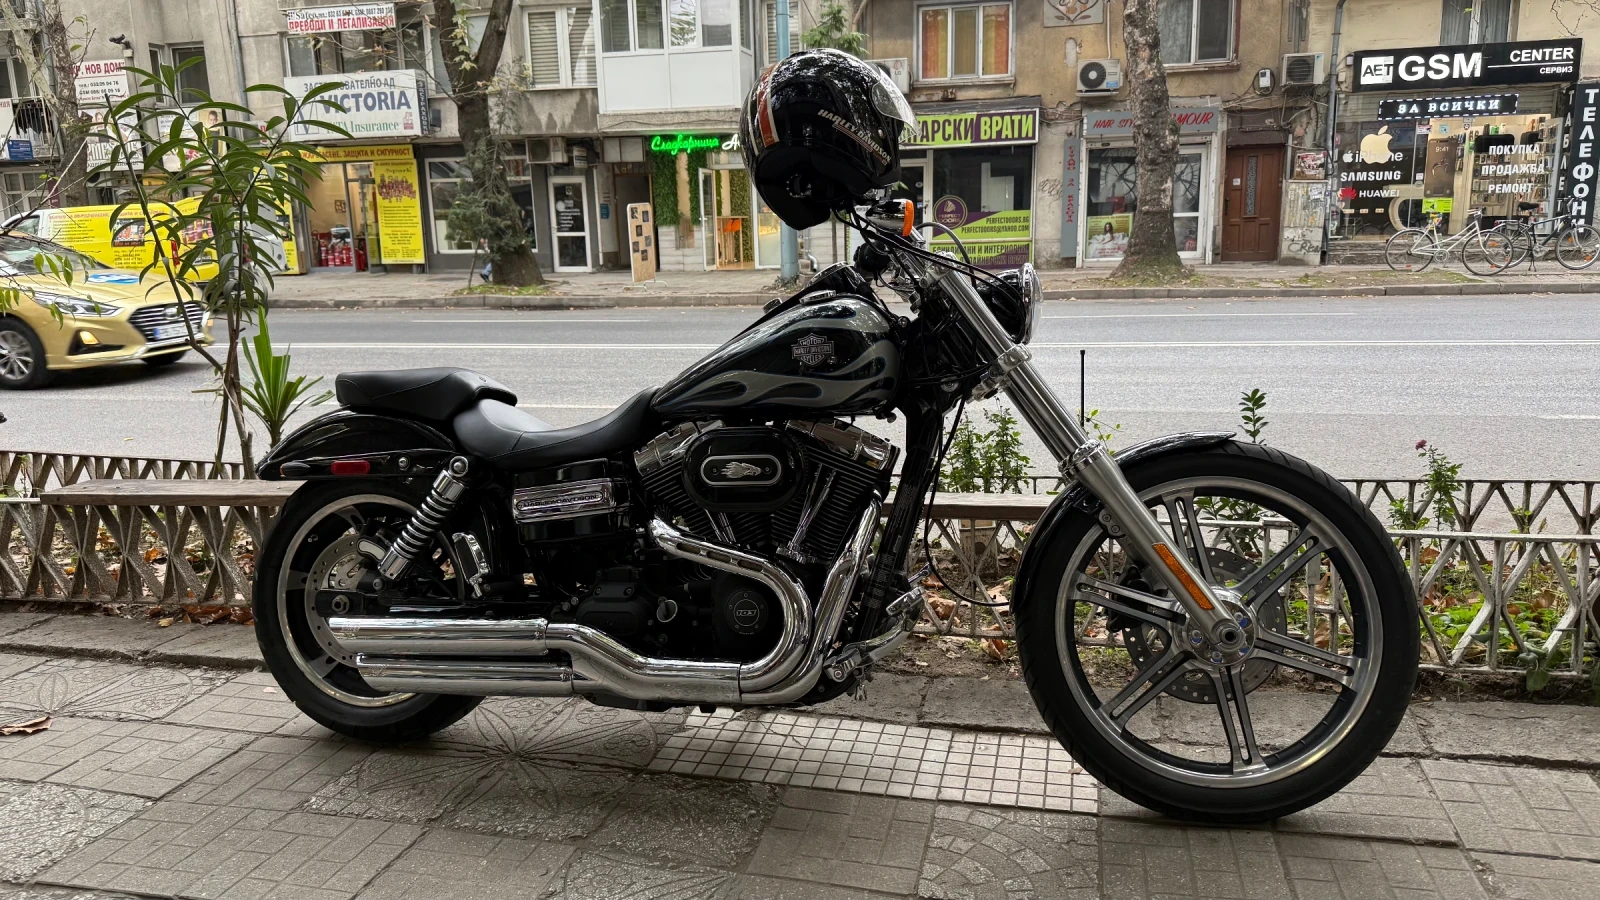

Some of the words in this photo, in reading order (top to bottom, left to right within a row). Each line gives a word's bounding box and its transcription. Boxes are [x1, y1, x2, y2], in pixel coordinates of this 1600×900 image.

[289, 19, 326, 32] ПРЕВОДИ
[328, 18, 334, 30] И
[1510, 47, 1574, 63] CENTER
[1398, 52, 1482, 82] GSM
[1540, 66, 1573, 75] СЕРВИЗ
[384, 78, 396, 90] АД
[320, 90, 412, 114] VICTORIA
[1398, 102, 1419, 114] ЗА
[1428, 100, 1500, 113] ВСИЧКИ
[1093, 118, 1114, 130] HAIR
[1118, 118, 1134, 128] STY
[1173, 112, 1214, 126] MOUR
[351, 120, 399, 133] Insurance
[980, 114, 1033, 140] ВРАТИ
[652, 132, 719, 156] Сладкарница
[1489, 144, 1540, 155] ПОКУПКА
[344, 150, 369, 159] ЗАЩИТА
[377, 148, 410, 156] СИГУРНОСТ
[1340, 170, 1401, 182] SAMSUNG
[1482, 164, 1544, 176] ПРОДАЖБА
[1359, 190, 1400, 198] HUAWEI
[1488, 183, 1534, 194] РЕМОНТ
[986, 216, 1029, 224] PERFECTDOORS.BG
